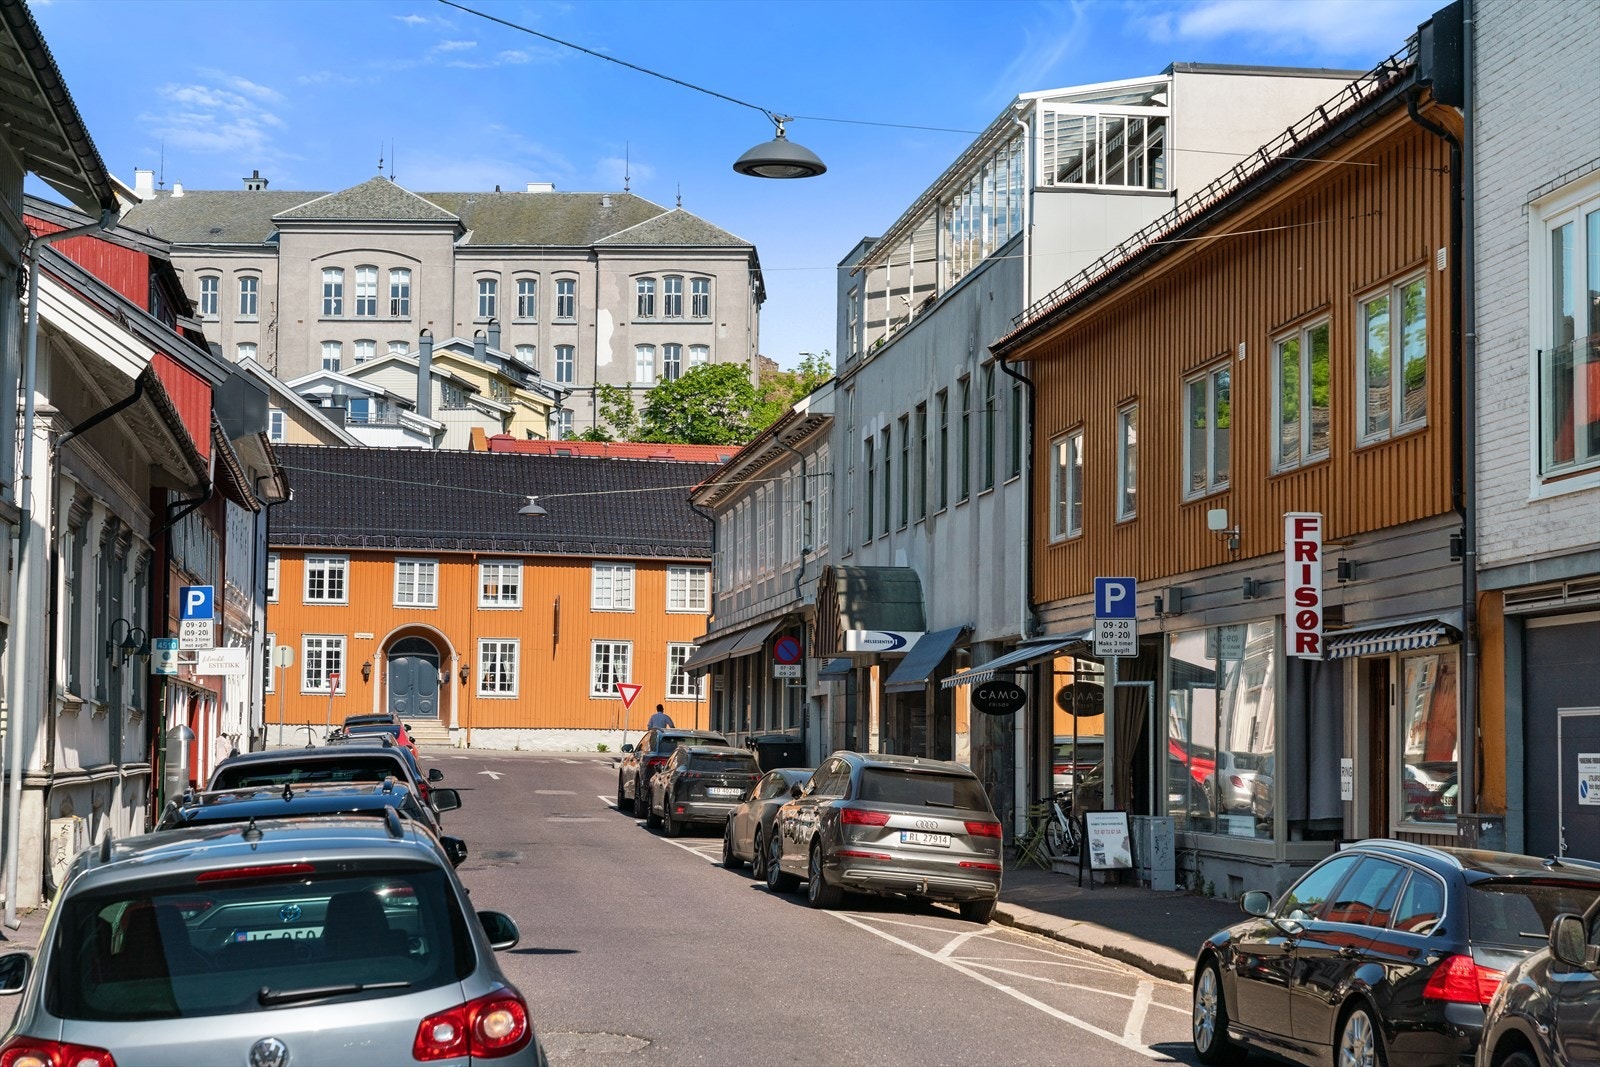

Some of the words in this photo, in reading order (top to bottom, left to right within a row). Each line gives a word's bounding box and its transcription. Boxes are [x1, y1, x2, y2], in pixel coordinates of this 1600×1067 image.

[1294, 518, 1319, 653] FRISØR
[187, 590, 205, 615] P
[1105, 582, 1126, 613] P
[1101, 631, 1130, 639] (09-20)
[157, 641, 177, 649] 4510
[979, 690, 1019, 700] CAMO
[909, 832, 919, 841] RL
[923, 834, 948, 844] 27914
